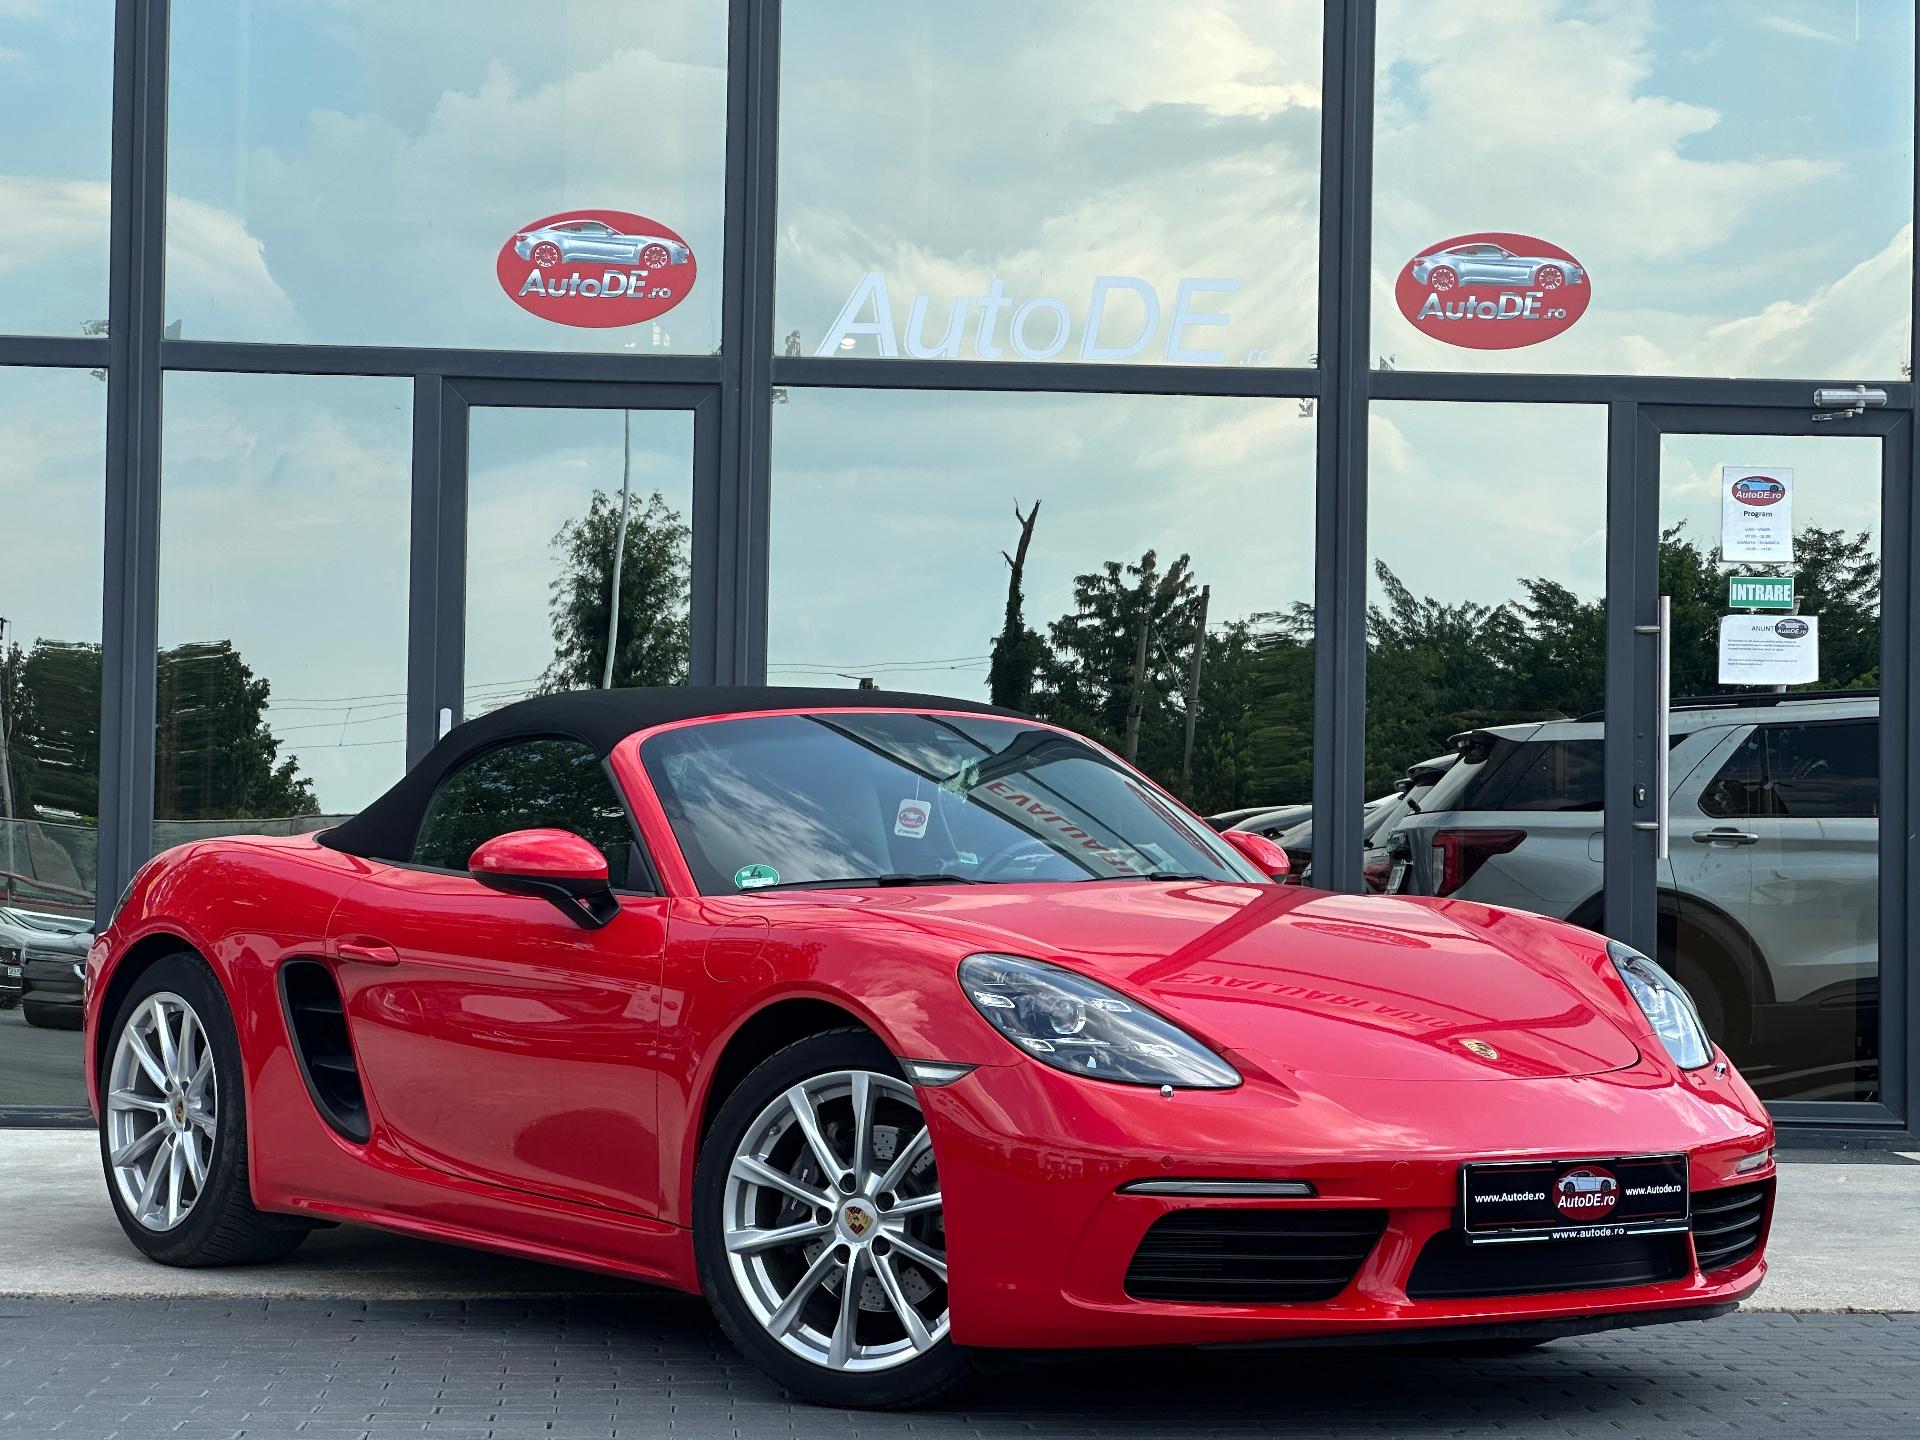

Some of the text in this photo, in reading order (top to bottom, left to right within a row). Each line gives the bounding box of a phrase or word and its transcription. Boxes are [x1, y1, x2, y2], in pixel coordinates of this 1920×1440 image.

[1735, 490, 1782, 500] AutoDE.ro
[1743, 510, 1773, 519] Program
[1732, 584, 1791, 602] INTRARE
[750, 866, 763, 879] 4
[1624, 1183, 1682, 1197] www.Autode.ro
[1474, 1191, 1546, 1204] www.Autode.ro
[1557, 1193, 1616, 1210] AutoDE.ro
[1552, 1226, 1625, 1240] www.autode.ro
